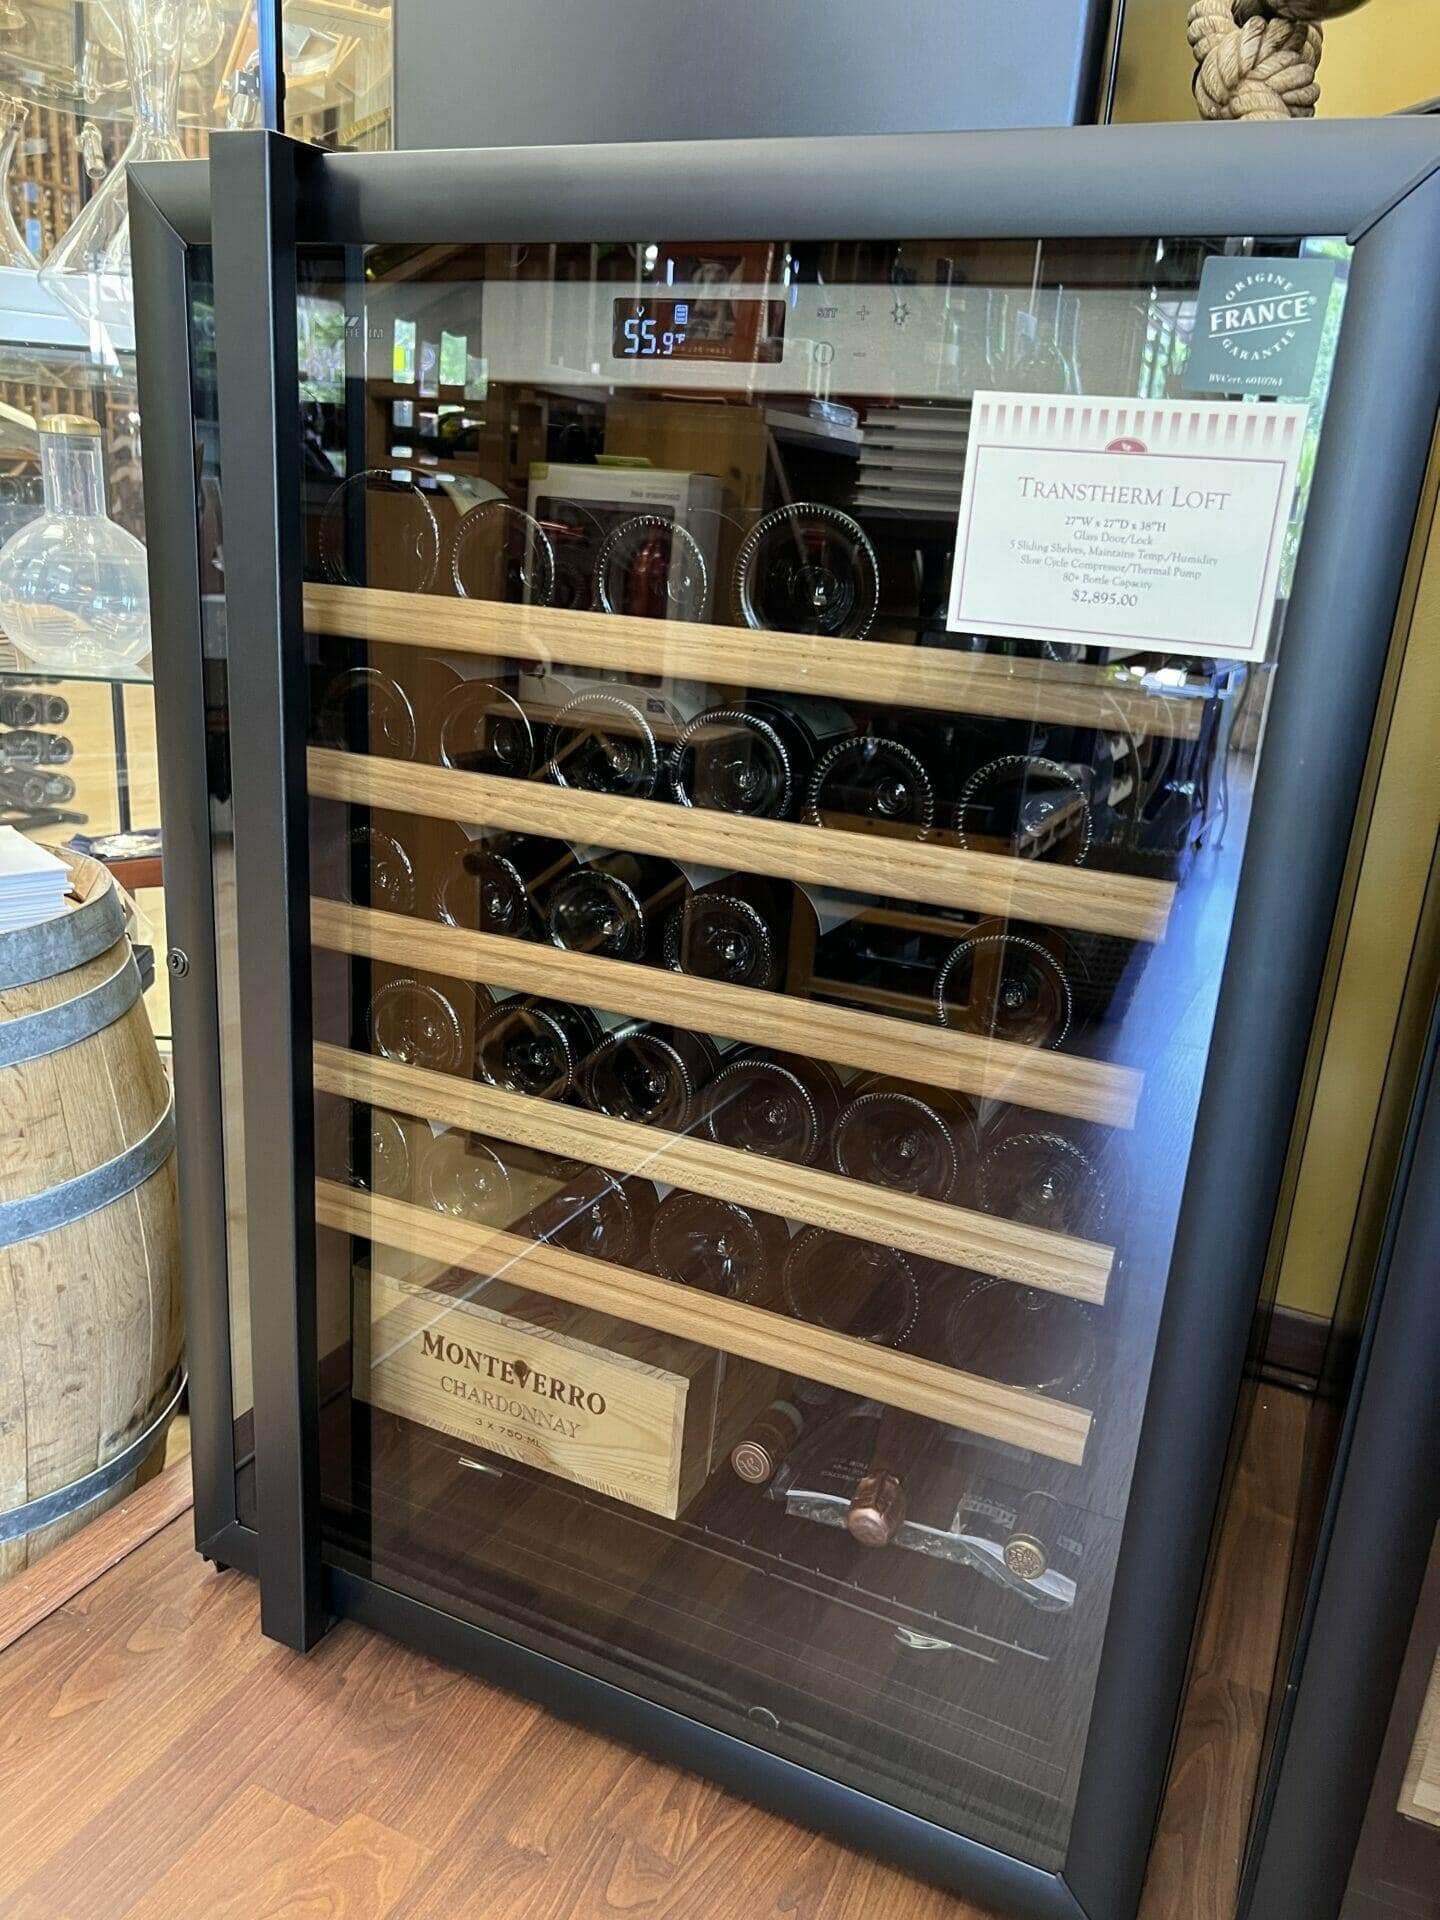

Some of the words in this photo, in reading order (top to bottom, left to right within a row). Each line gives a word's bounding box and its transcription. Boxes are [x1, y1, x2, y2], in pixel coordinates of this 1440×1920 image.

[1225, 273, 1293, 301] ORIGINE
[1222, 328, 1296, 361] GARANTIE
[1017, 476, 1164, 507] TRANSTHERM
[1171, 486, 1232, 511] LOFT
[1009, 540, 1016, 550] 5
[1017, 540, 1049, 554] Sliding
[1073, 530, 1099, 542] Glass
[1101, 532, 1153, 546] Door/Lock
[1020, 555, 1041, 565] Slow
[1044, 557, 1069, 570] Cycle
[1071, 560, 1171, 577] Compressor/Thermal
[1173, 567, 1202, 581] Pump
[1062, 572, 1080, 583] 80+
[1082, 573, 1109, 586] Bottle
[1112, 576, 1152, 590] Capacity
[1072, 588, 1139, 608] $2,895.00
[421, 1330, 607, 1415] MONTEVERRO
[440, 1376, 582, 1439] CHARDONNAY
[475, 1418, 484, 1427] 3
[500, 1425, 523, 1441] 750
